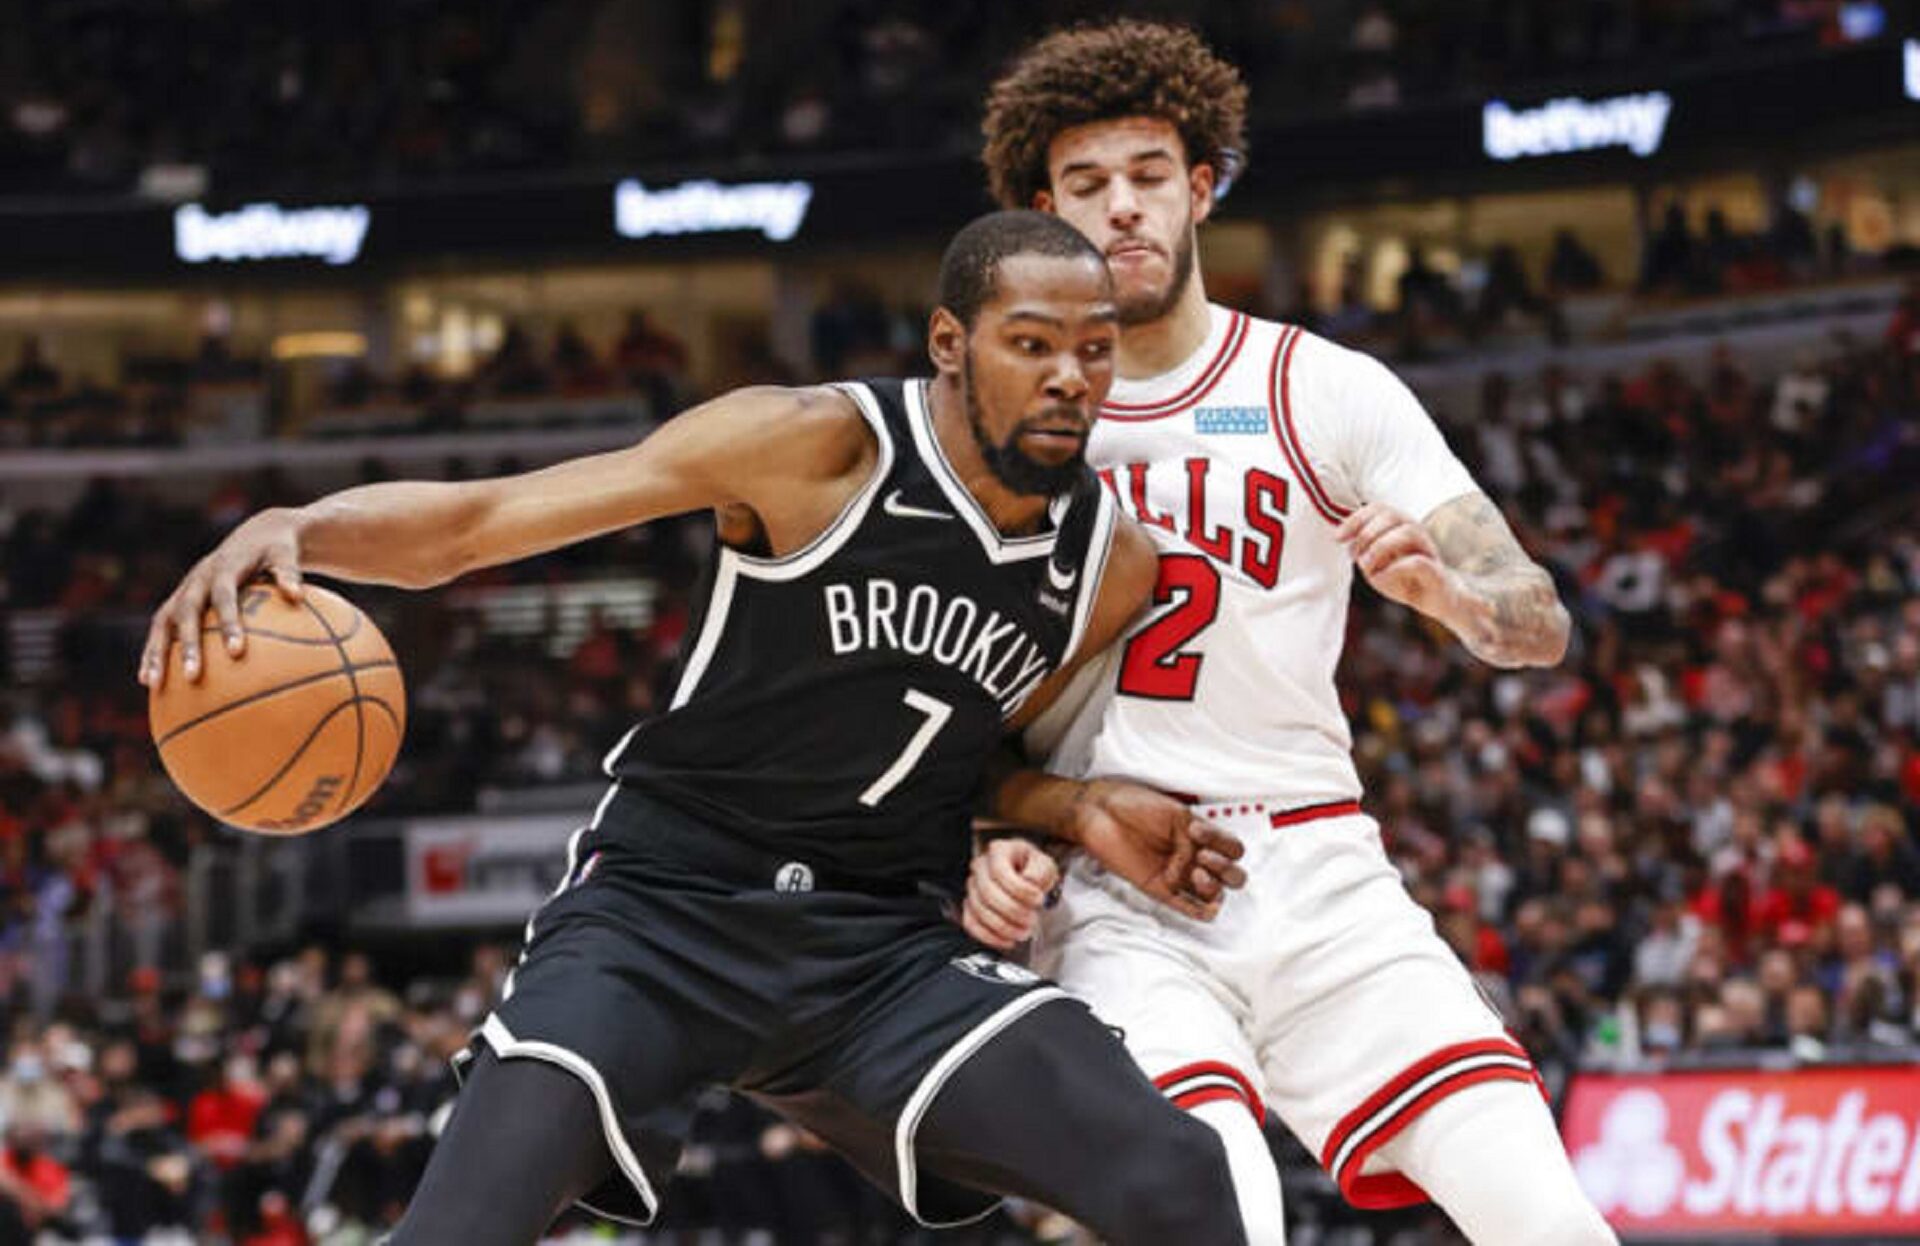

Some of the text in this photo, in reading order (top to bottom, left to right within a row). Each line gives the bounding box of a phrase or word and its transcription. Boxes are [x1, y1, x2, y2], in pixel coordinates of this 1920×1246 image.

[1483, 91, 1671, 159] betway
[1098, 457, 1289, 590] LLS
[1117, 552, 1221, 702] 2
[859, 688, 953, 807] 7
